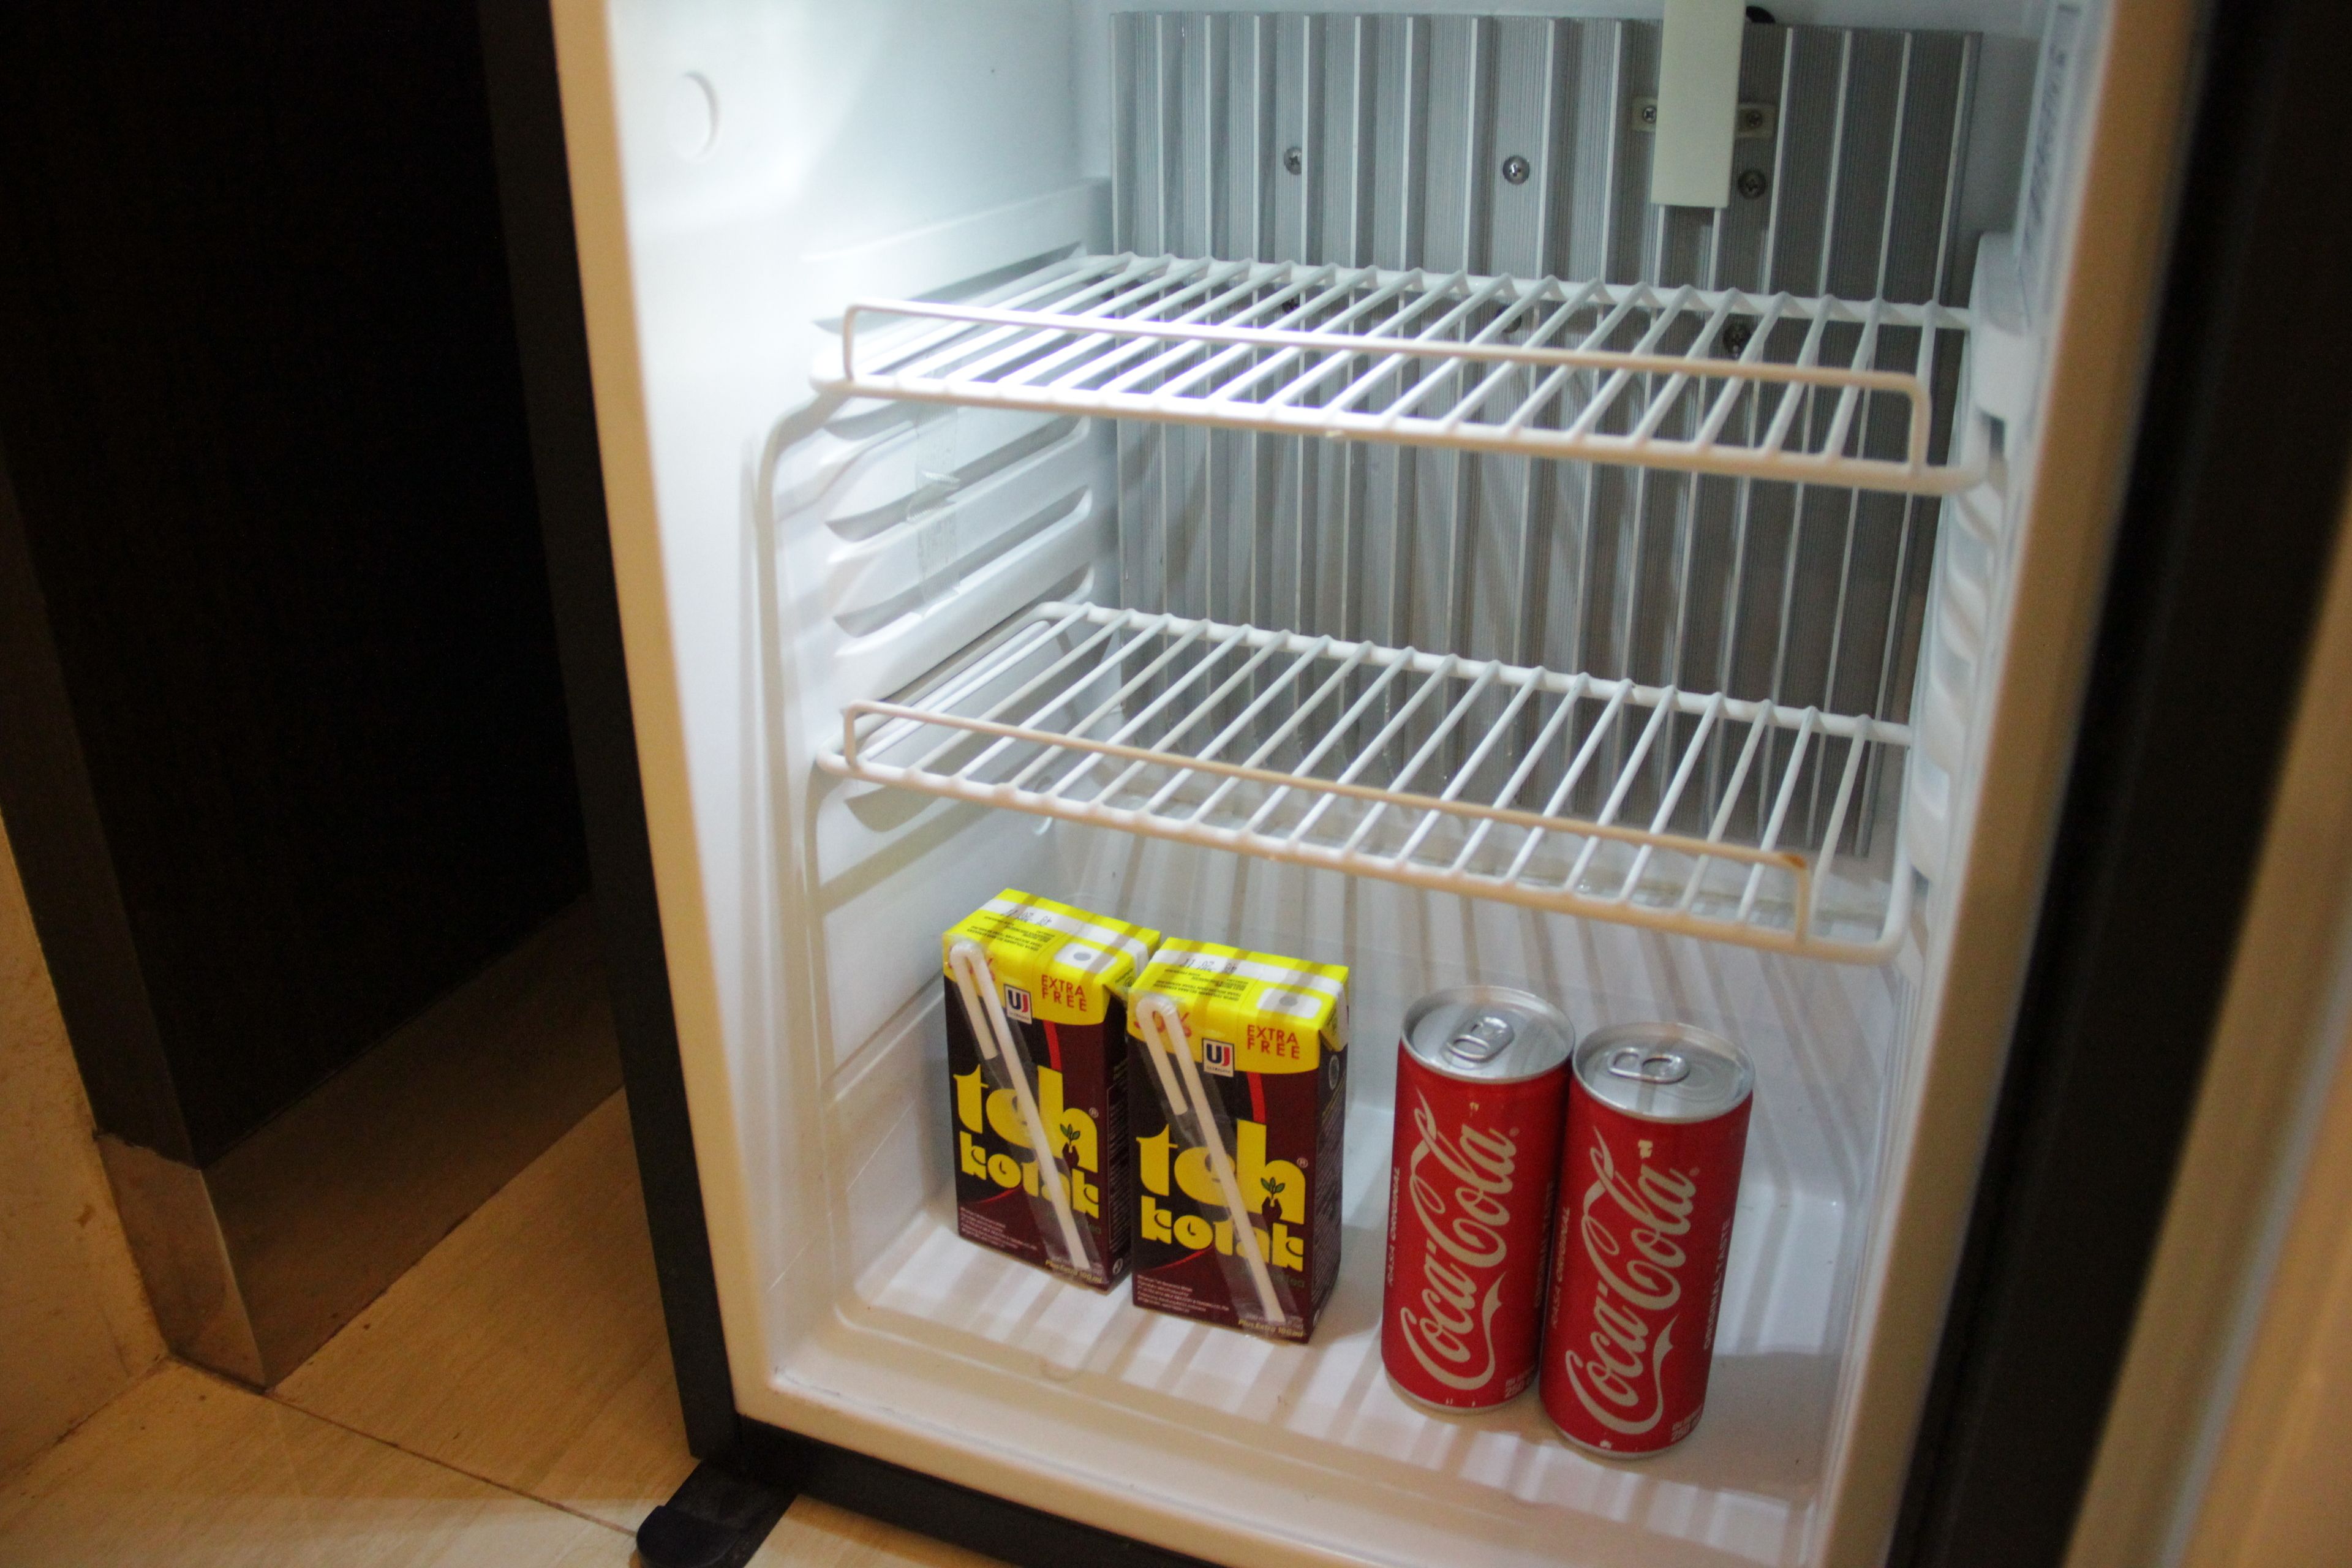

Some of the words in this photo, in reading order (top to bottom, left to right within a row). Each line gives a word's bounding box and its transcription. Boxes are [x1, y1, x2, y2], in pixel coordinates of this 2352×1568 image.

[1041, 974, 1085, 997] EXTRA
[1042, 987, 1087, 1011] FREE
[1247, 1024, 1298, 1045] EXTRA
[1247, 1038, 1300, 1060] FREE
[952, 1063, 1098, 1173] teh
[1136, 1118, 1306, 1225] teh
[1400, 1085, 1517, 1390] Coca-Cola
[1566, 1125, 1697, 1434] Coca-Cola
